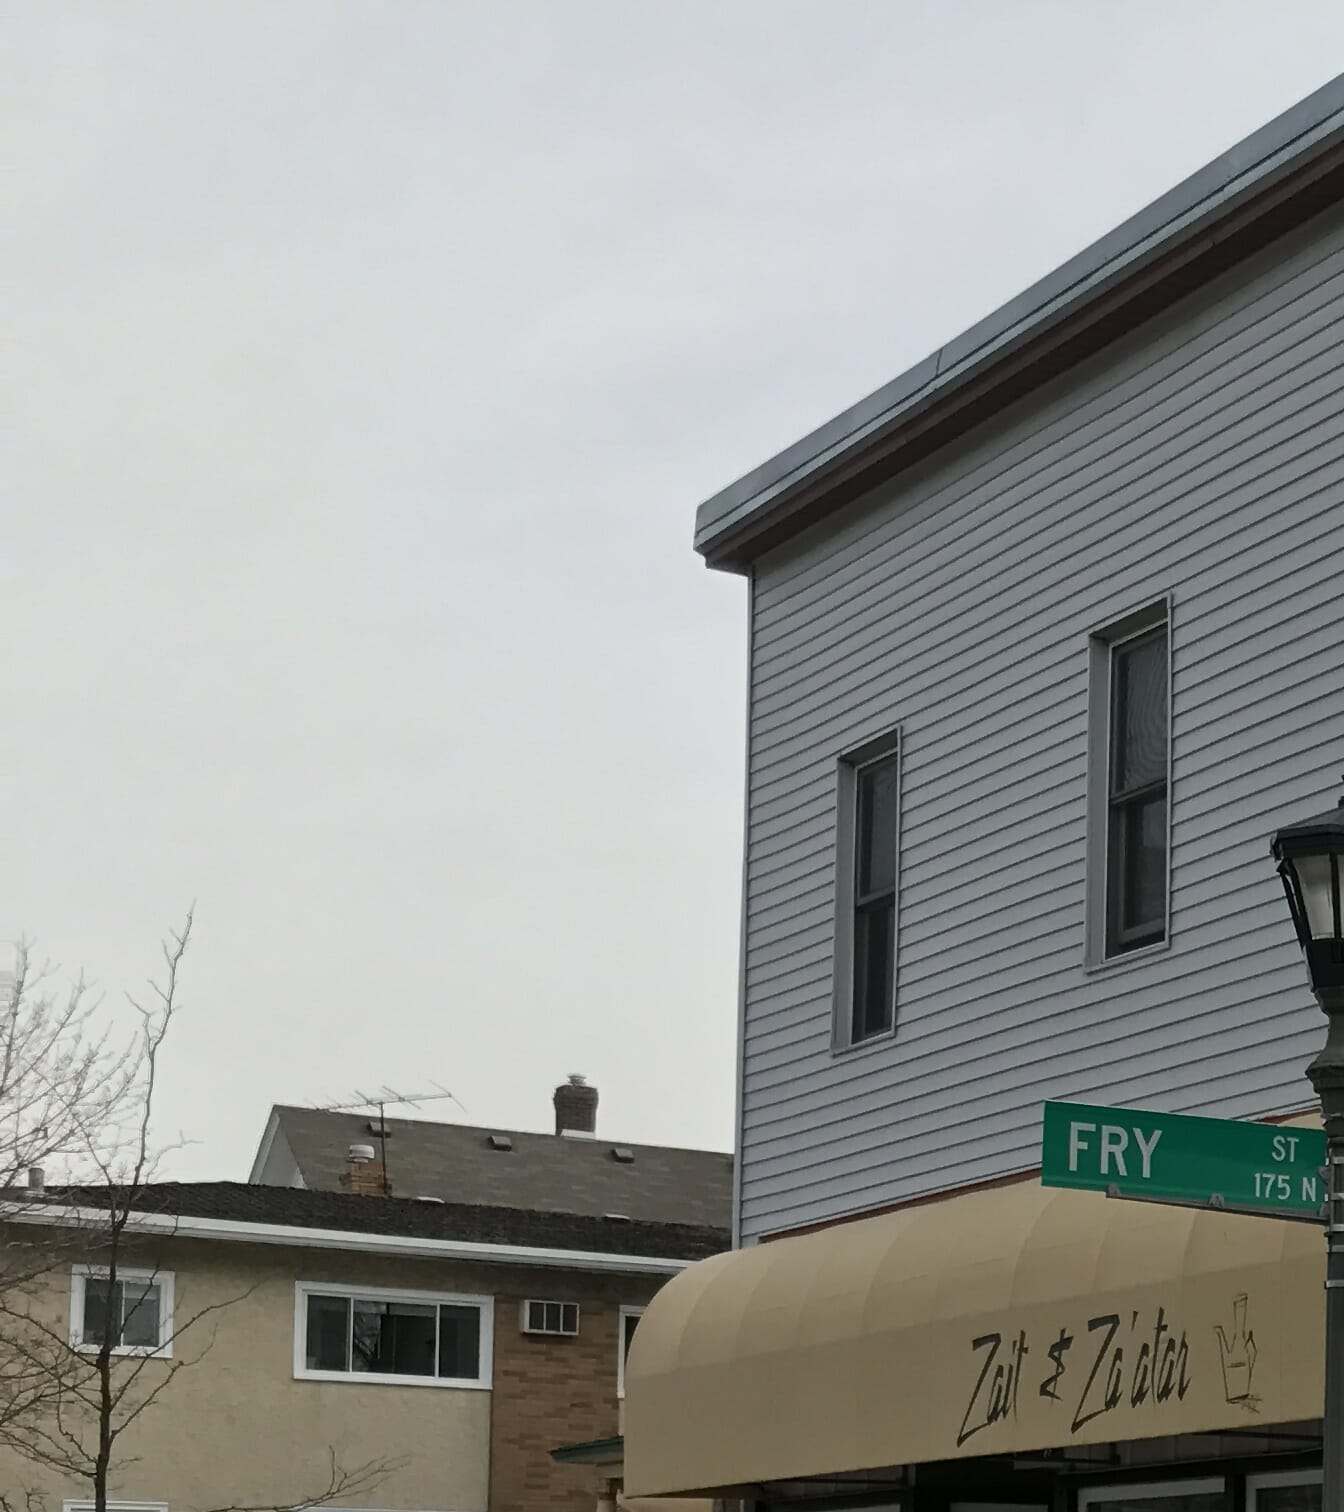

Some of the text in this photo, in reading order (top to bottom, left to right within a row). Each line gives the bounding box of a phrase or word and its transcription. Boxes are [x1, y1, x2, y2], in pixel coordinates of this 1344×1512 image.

[1068, 1122, 1163, 1178] FRY
[1271, 1135, 1299, 1162] ST
[1254, 1172, 1316, 1202] 175 N
[957, 1329, 1029, 1448] Zait
[1039, 1328, 1073, 1400] &
